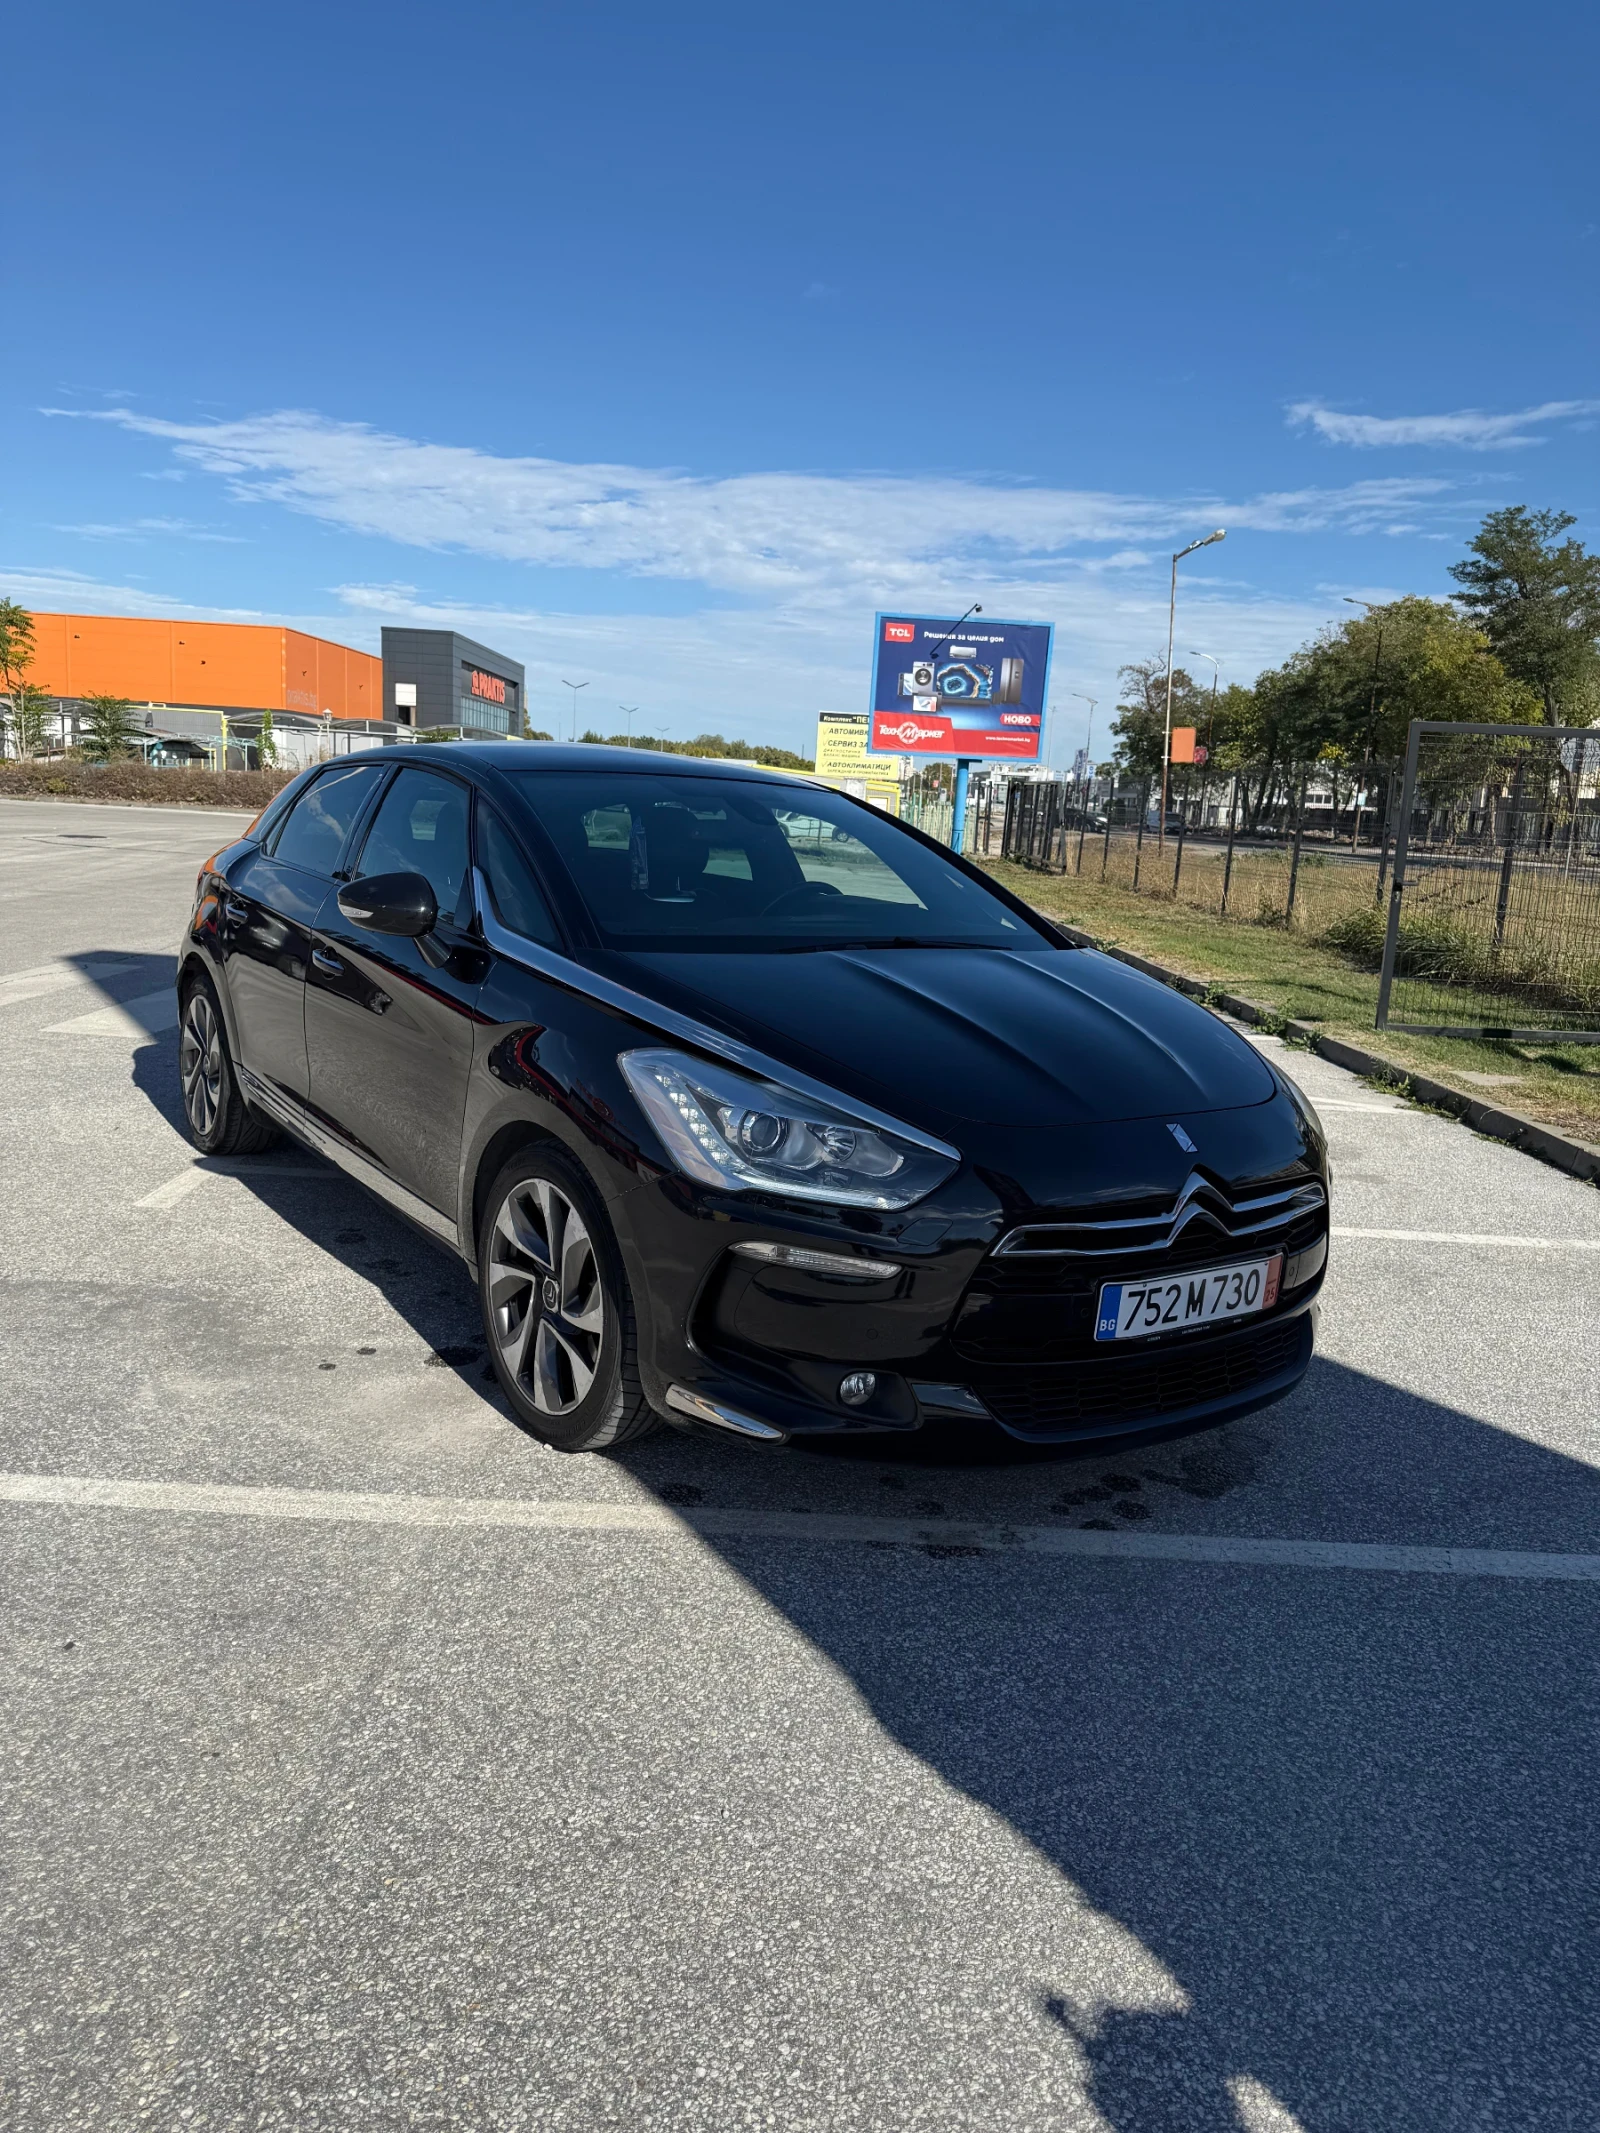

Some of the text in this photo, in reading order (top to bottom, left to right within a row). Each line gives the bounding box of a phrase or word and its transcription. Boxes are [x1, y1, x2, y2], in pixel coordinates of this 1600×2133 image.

[890, 628, 910, 637] TCL
[924, 631, 957, 640] Решения
[479, 671, 506, 704] PRAKTIS
[1003, 715, 1032, 725] НОВО
[826, 761, 892, 771] АВТОКЛИМАТИЦИ
[1099, 1318, 1116, 1331] BG
